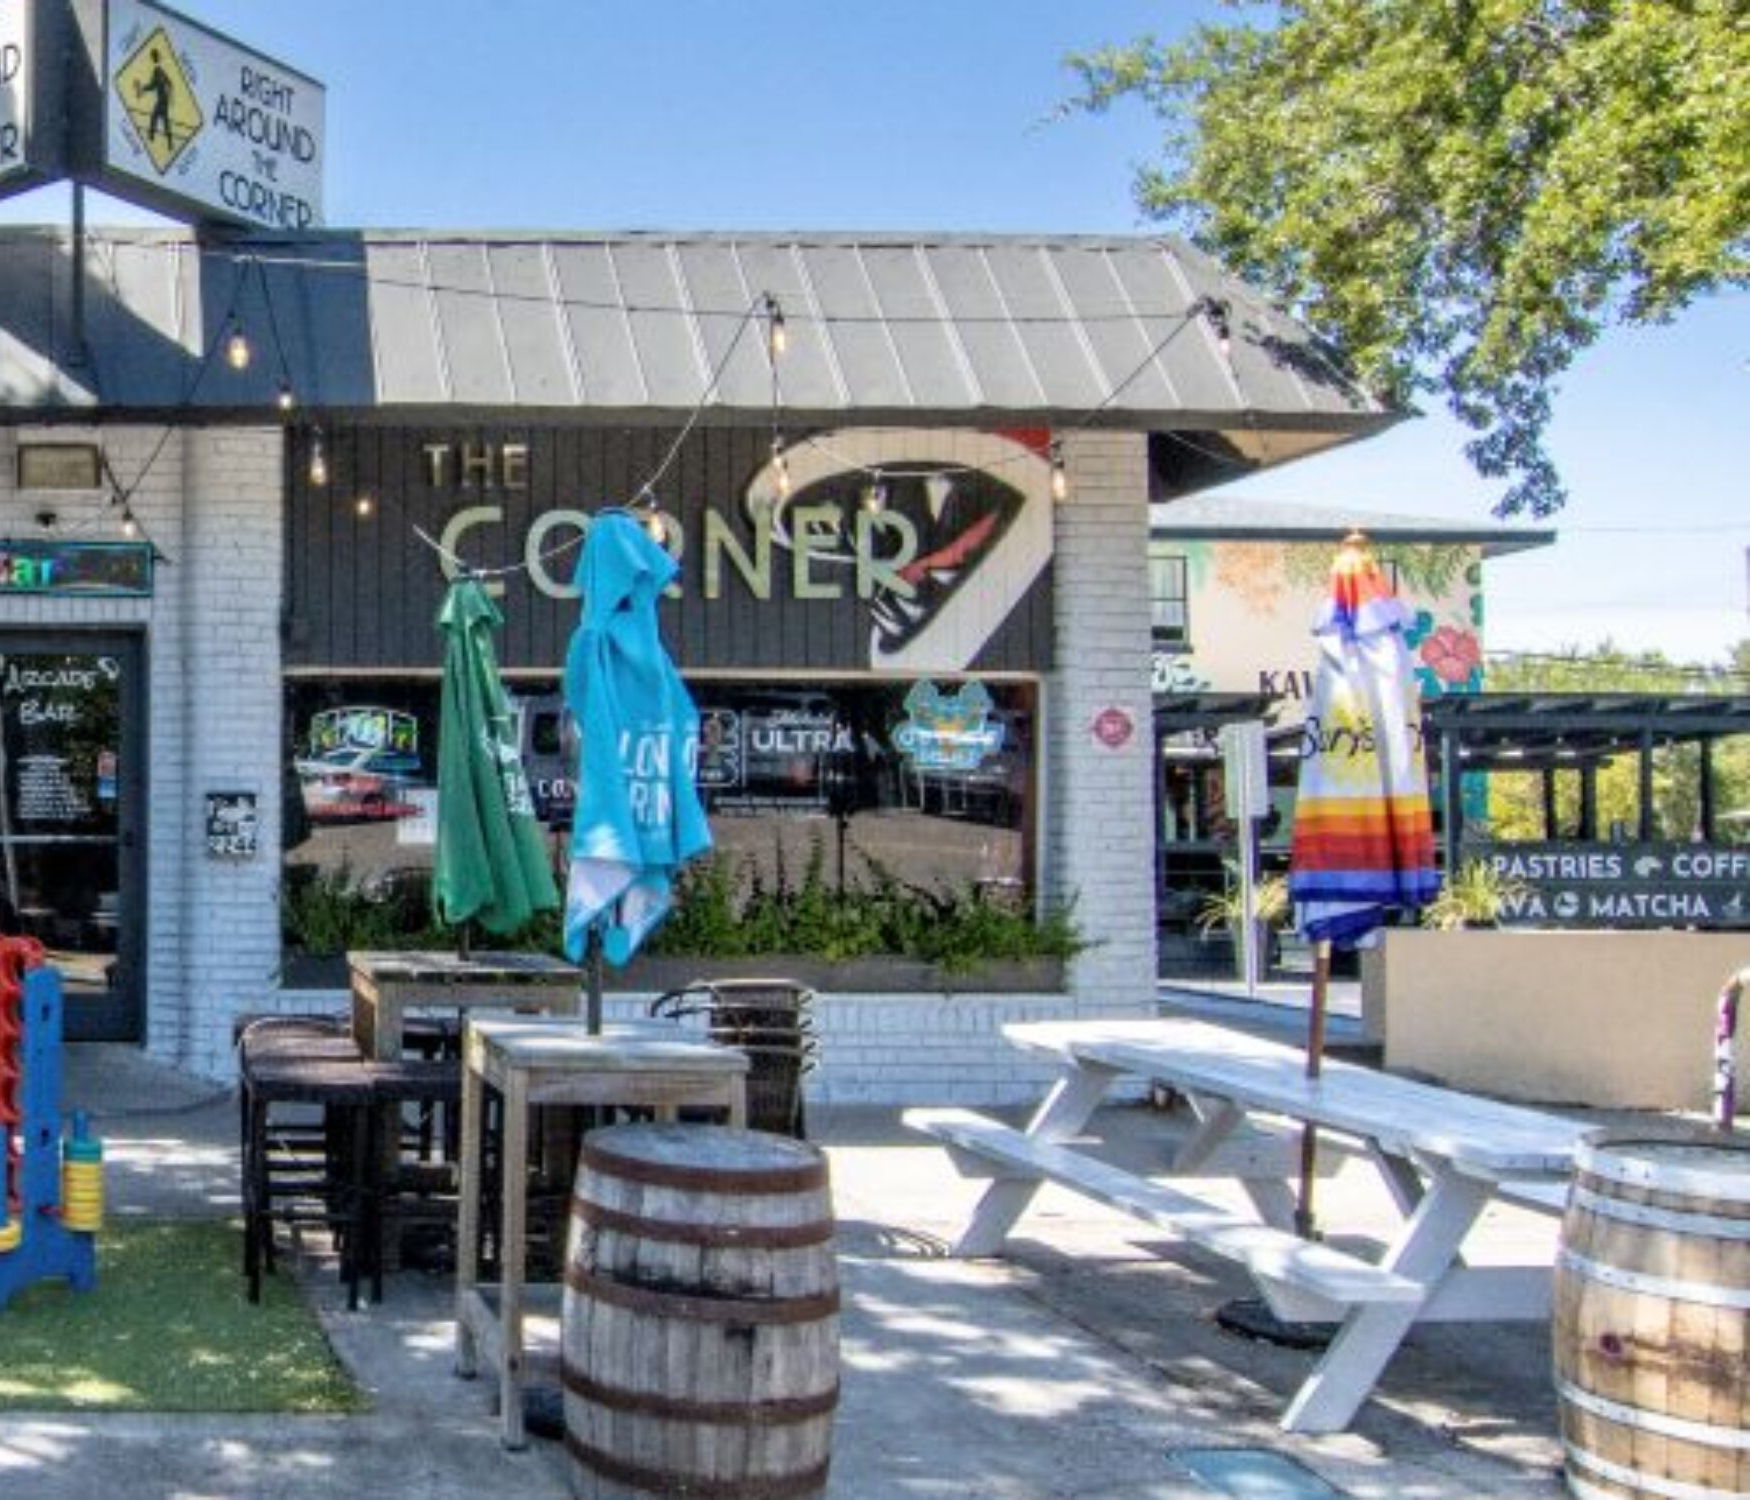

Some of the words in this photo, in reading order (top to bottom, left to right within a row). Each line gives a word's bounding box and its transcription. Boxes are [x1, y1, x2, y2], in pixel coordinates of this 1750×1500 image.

[240, 65, 294, 115] RIGHT
[214, 93, 316, 163] AROUND
[219, 170, 312, 230] CORNER
[423, 443, 528, 489] THE
[752, 729, 855, 753] ULTRA
[1493, 855, 1622, 879] PASTRIES
[1672, 854, 1750, 879] COFF
[1590, 894, 1711, 918] MATCHA
